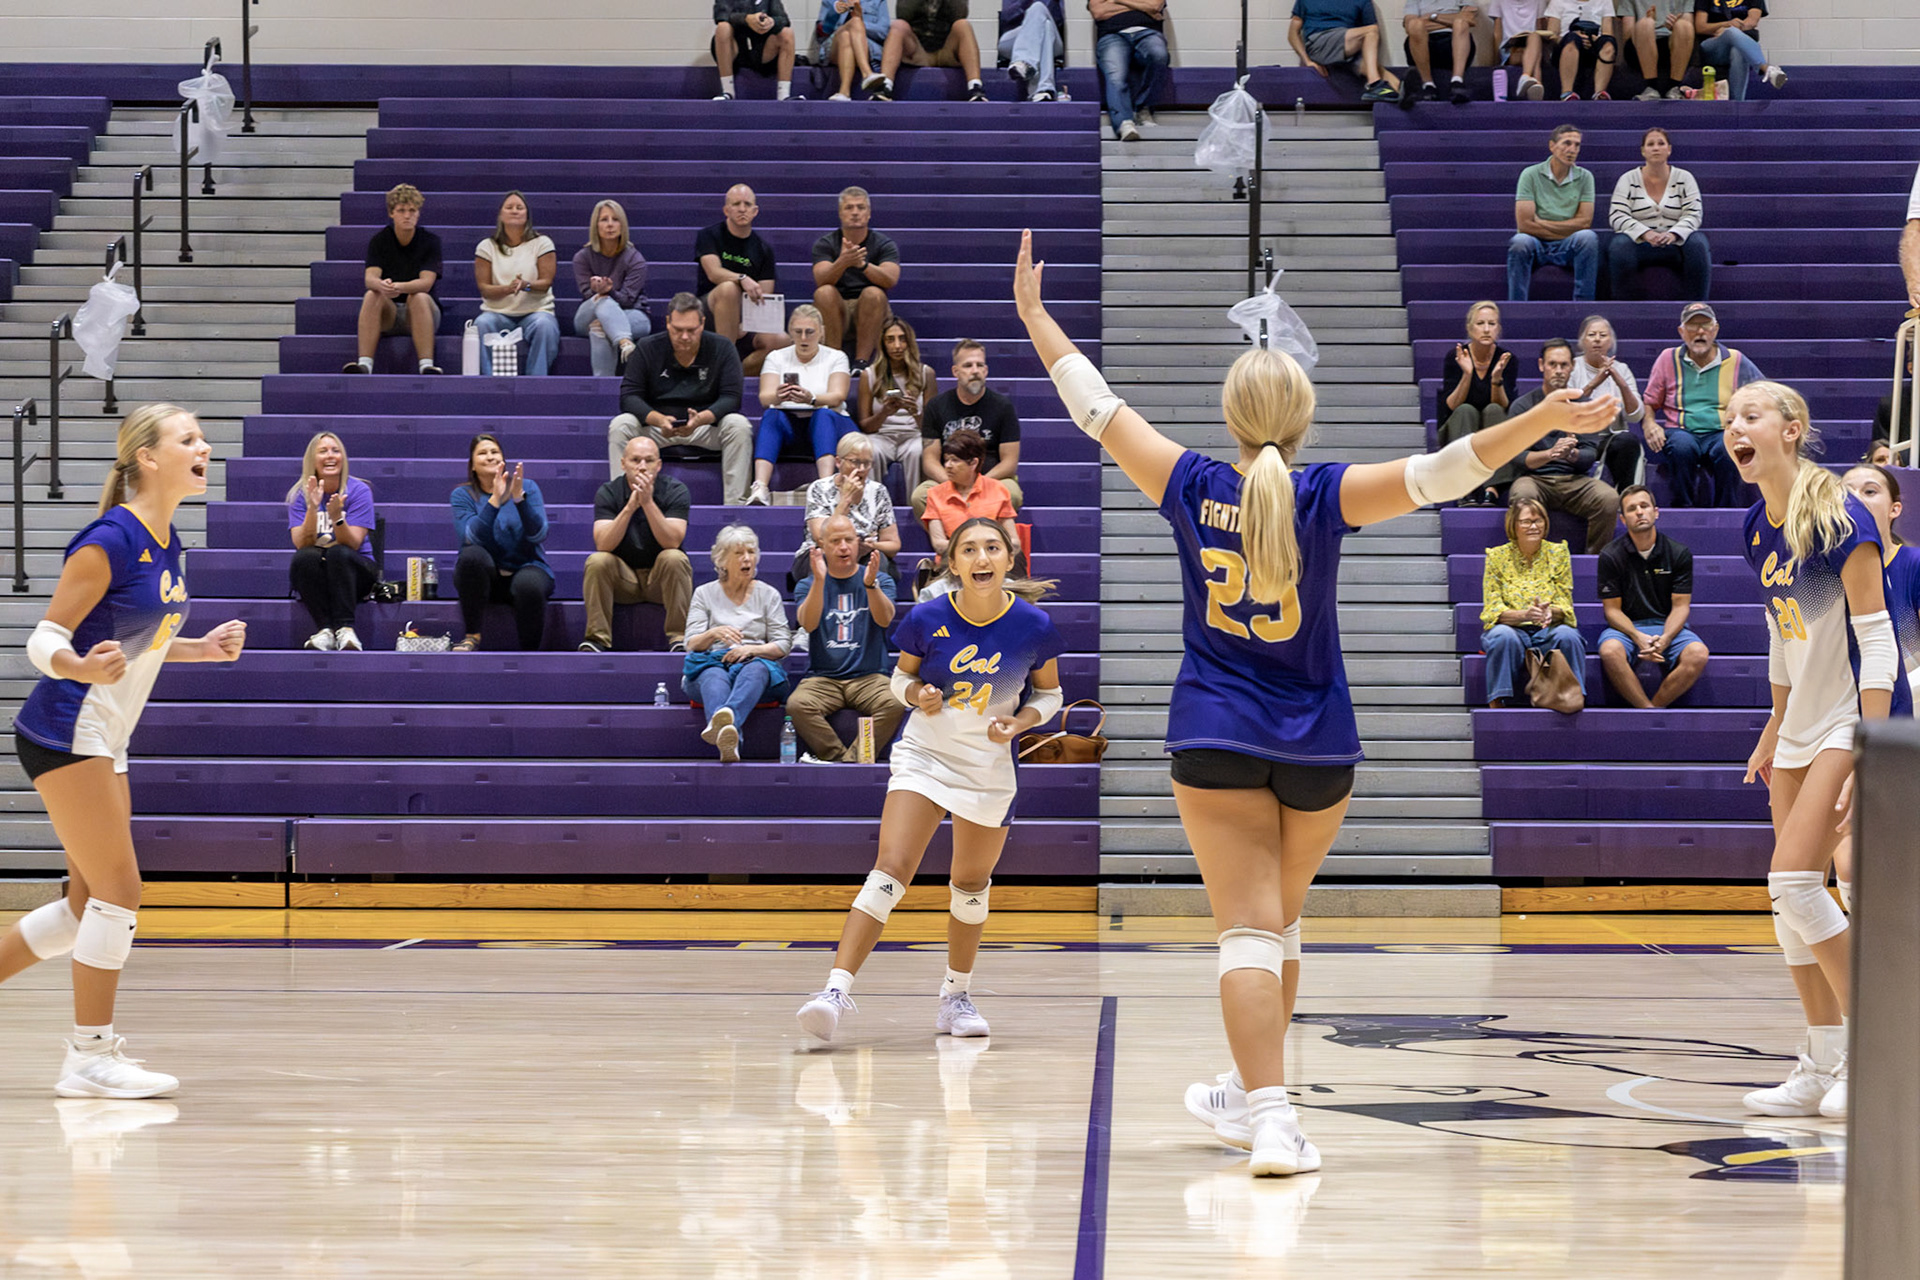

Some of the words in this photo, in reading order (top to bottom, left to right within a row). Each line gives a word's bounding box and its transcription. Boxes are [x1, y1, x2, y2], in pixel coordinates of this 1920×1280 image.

[1761, 551, 1794, 587] Cal
[1772, 597, 1807, 641] 20
[949, 644, 1001, 674] Cal
[948, 681, 993, 716] 24
